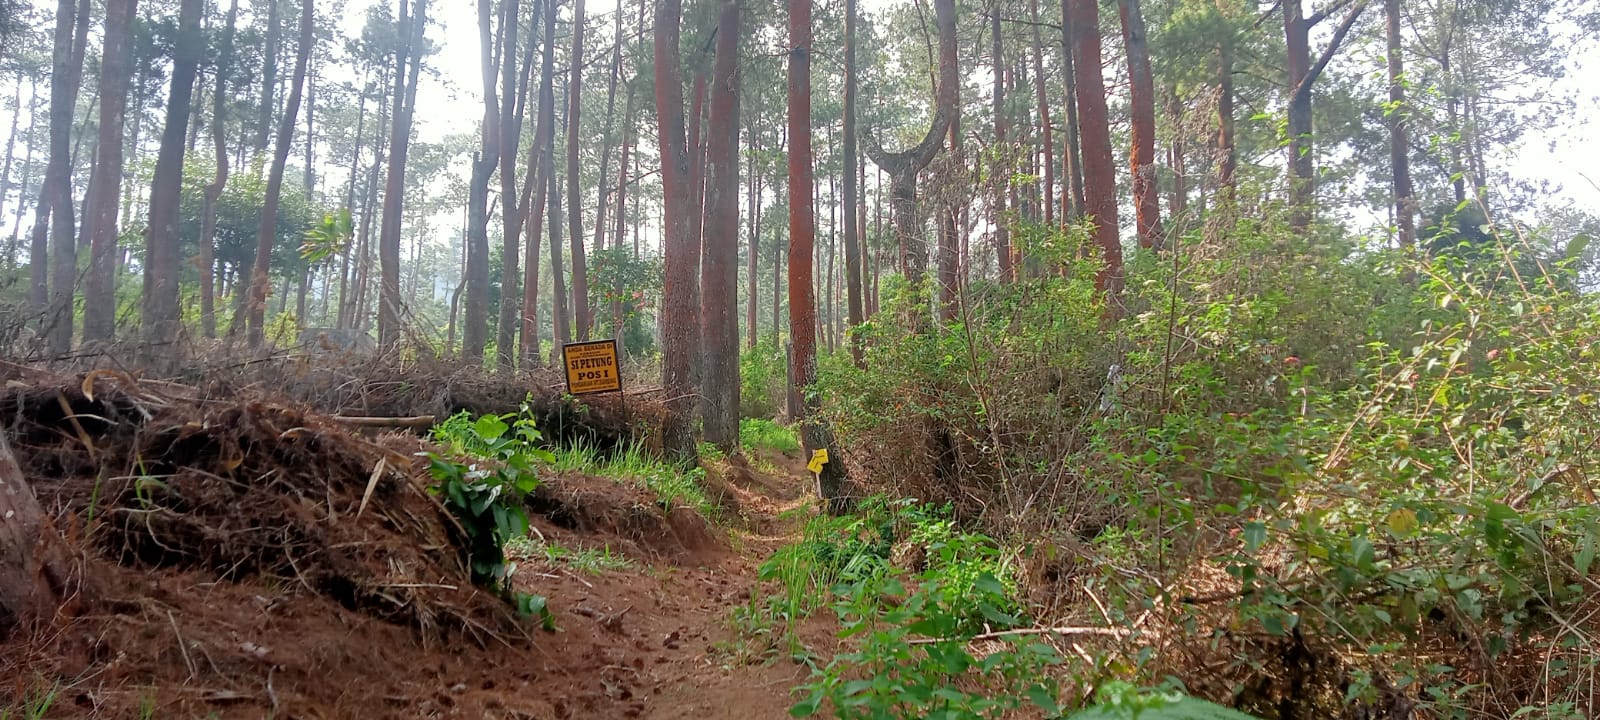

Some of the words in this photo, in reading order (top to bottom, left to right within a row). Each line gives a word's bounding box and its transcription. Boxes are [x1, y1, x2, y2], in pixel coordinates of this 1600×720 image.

[571, 359, 579, 370] SI
[580, 356, 612, 369] PETUNG
[578, 370, 601, 380] POS
